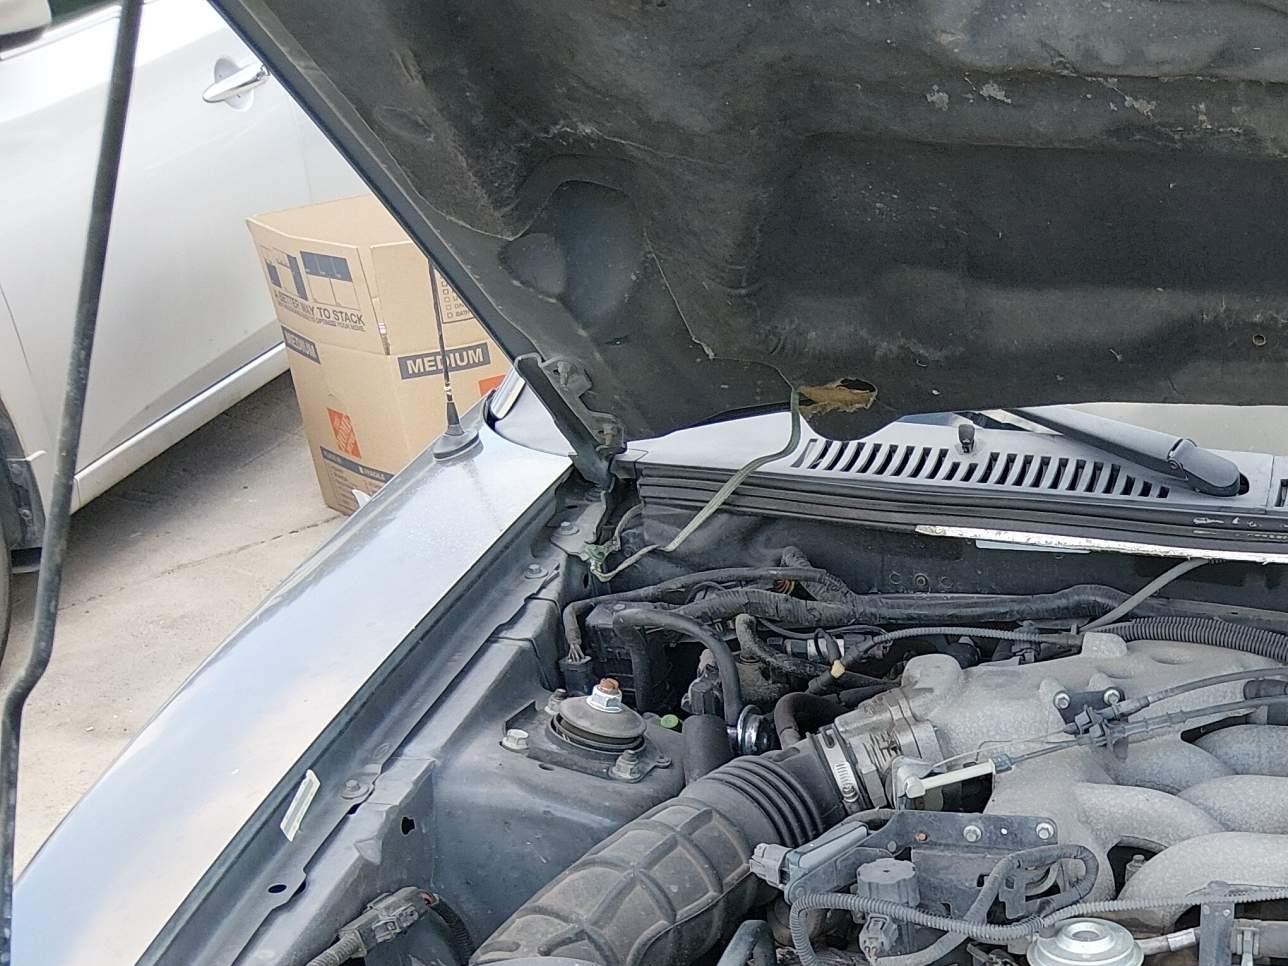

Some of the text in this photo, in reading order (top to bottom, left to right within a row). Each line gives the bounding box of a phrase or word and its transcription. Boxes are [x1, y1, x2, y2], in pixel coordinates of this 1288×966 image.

[316, 306, 331, 320] TO
[332, 309, 366, 327] STACK
[406, 347, 485, 375] MEDIUM
